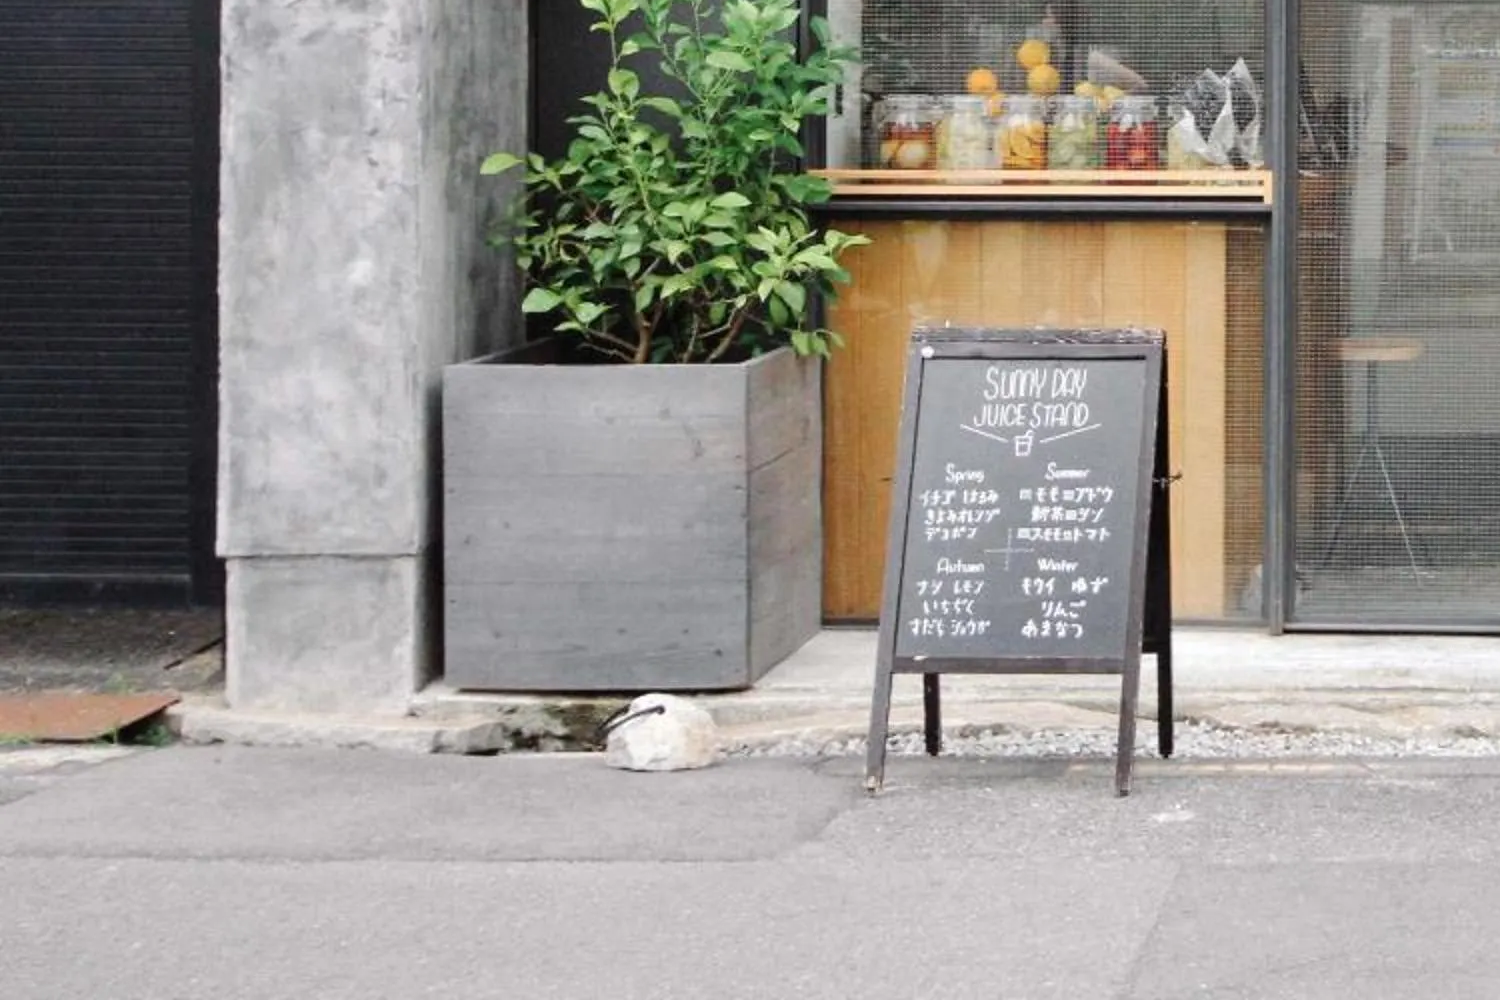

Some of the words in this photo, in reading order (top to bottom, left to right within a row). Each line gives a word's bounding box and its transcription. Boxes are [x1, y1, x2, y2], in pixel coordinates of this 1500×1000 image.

[983, 366, 1047, 400] SUNNY
[1051, 367, 1088, 399] DAY
[973, 402, 1026, 427] JUICE
[1030, 401, 1089, 428] STAND
[945, 462, 985, 485] Spring
